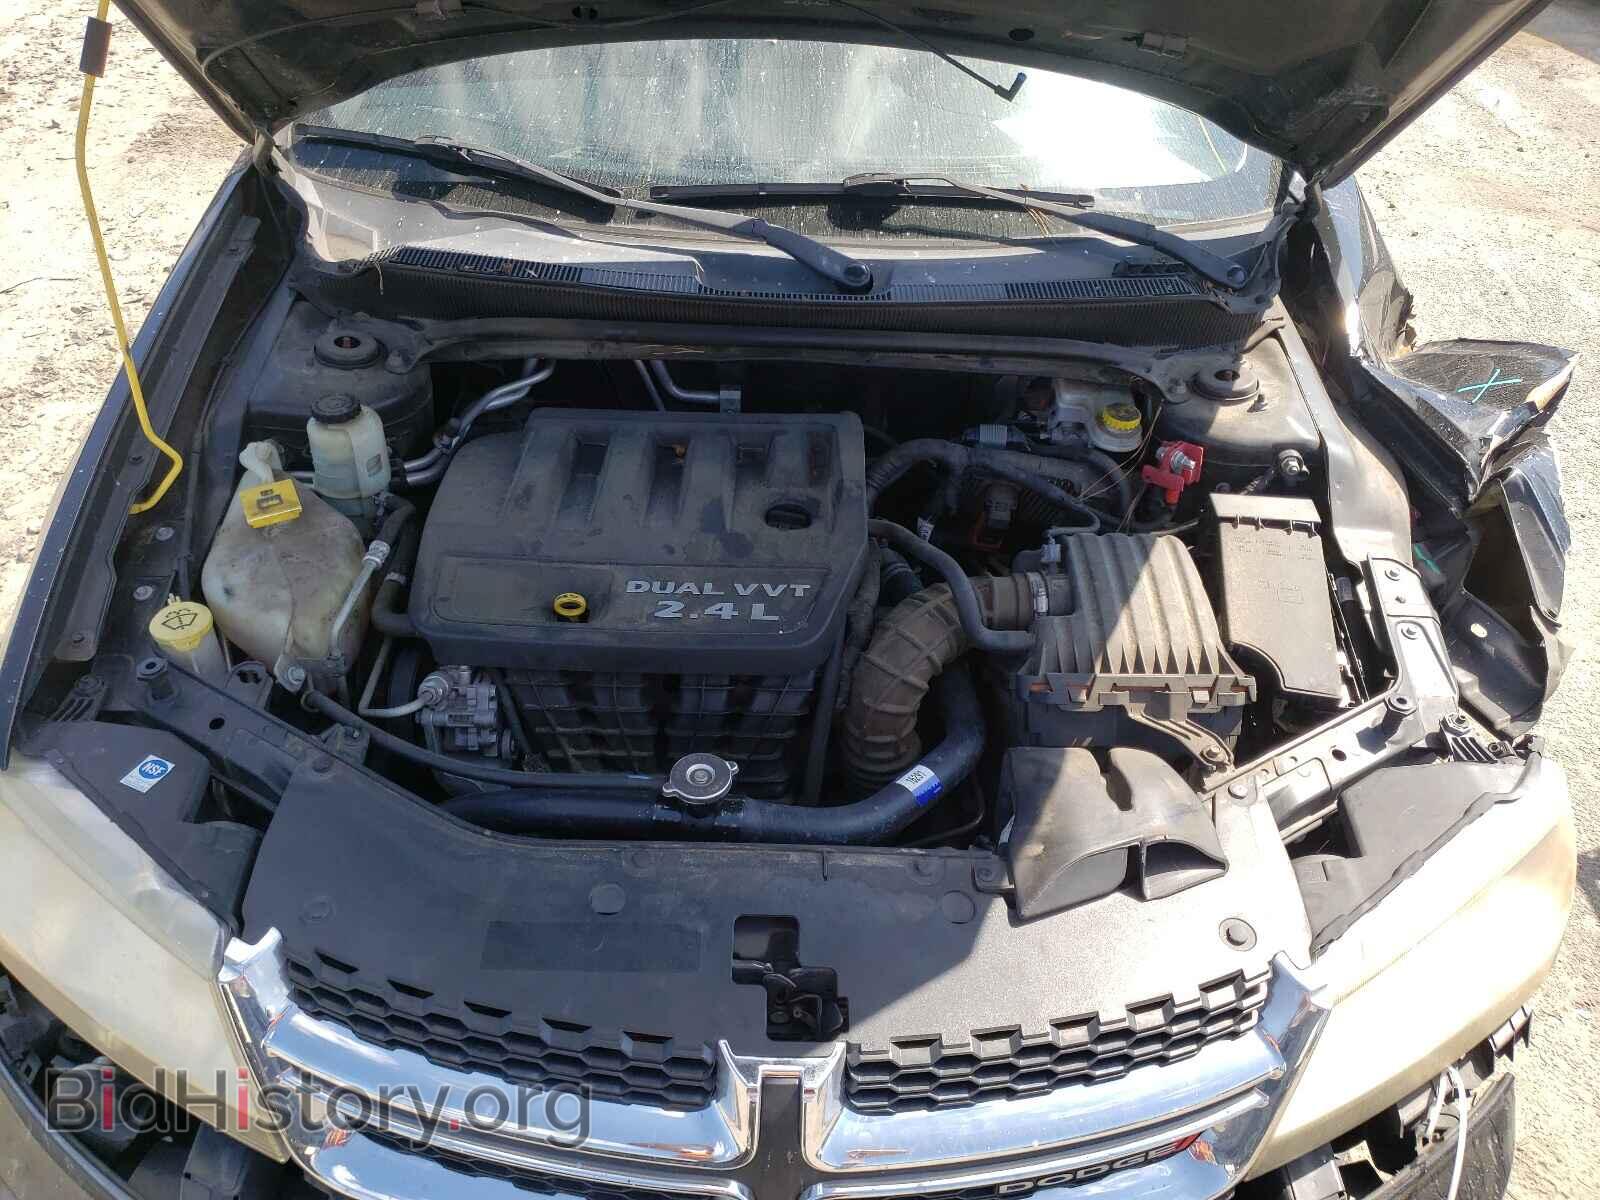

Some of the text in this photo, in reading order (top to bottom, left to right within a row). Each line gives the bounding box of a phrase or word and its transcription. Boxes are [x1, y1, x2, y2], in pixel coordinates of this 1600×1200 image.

[625, 580, 811, 596] DUAL VVT
[141, 762, 167, 775] NSF
[998, 1143, 1177, 1194] DODGE
